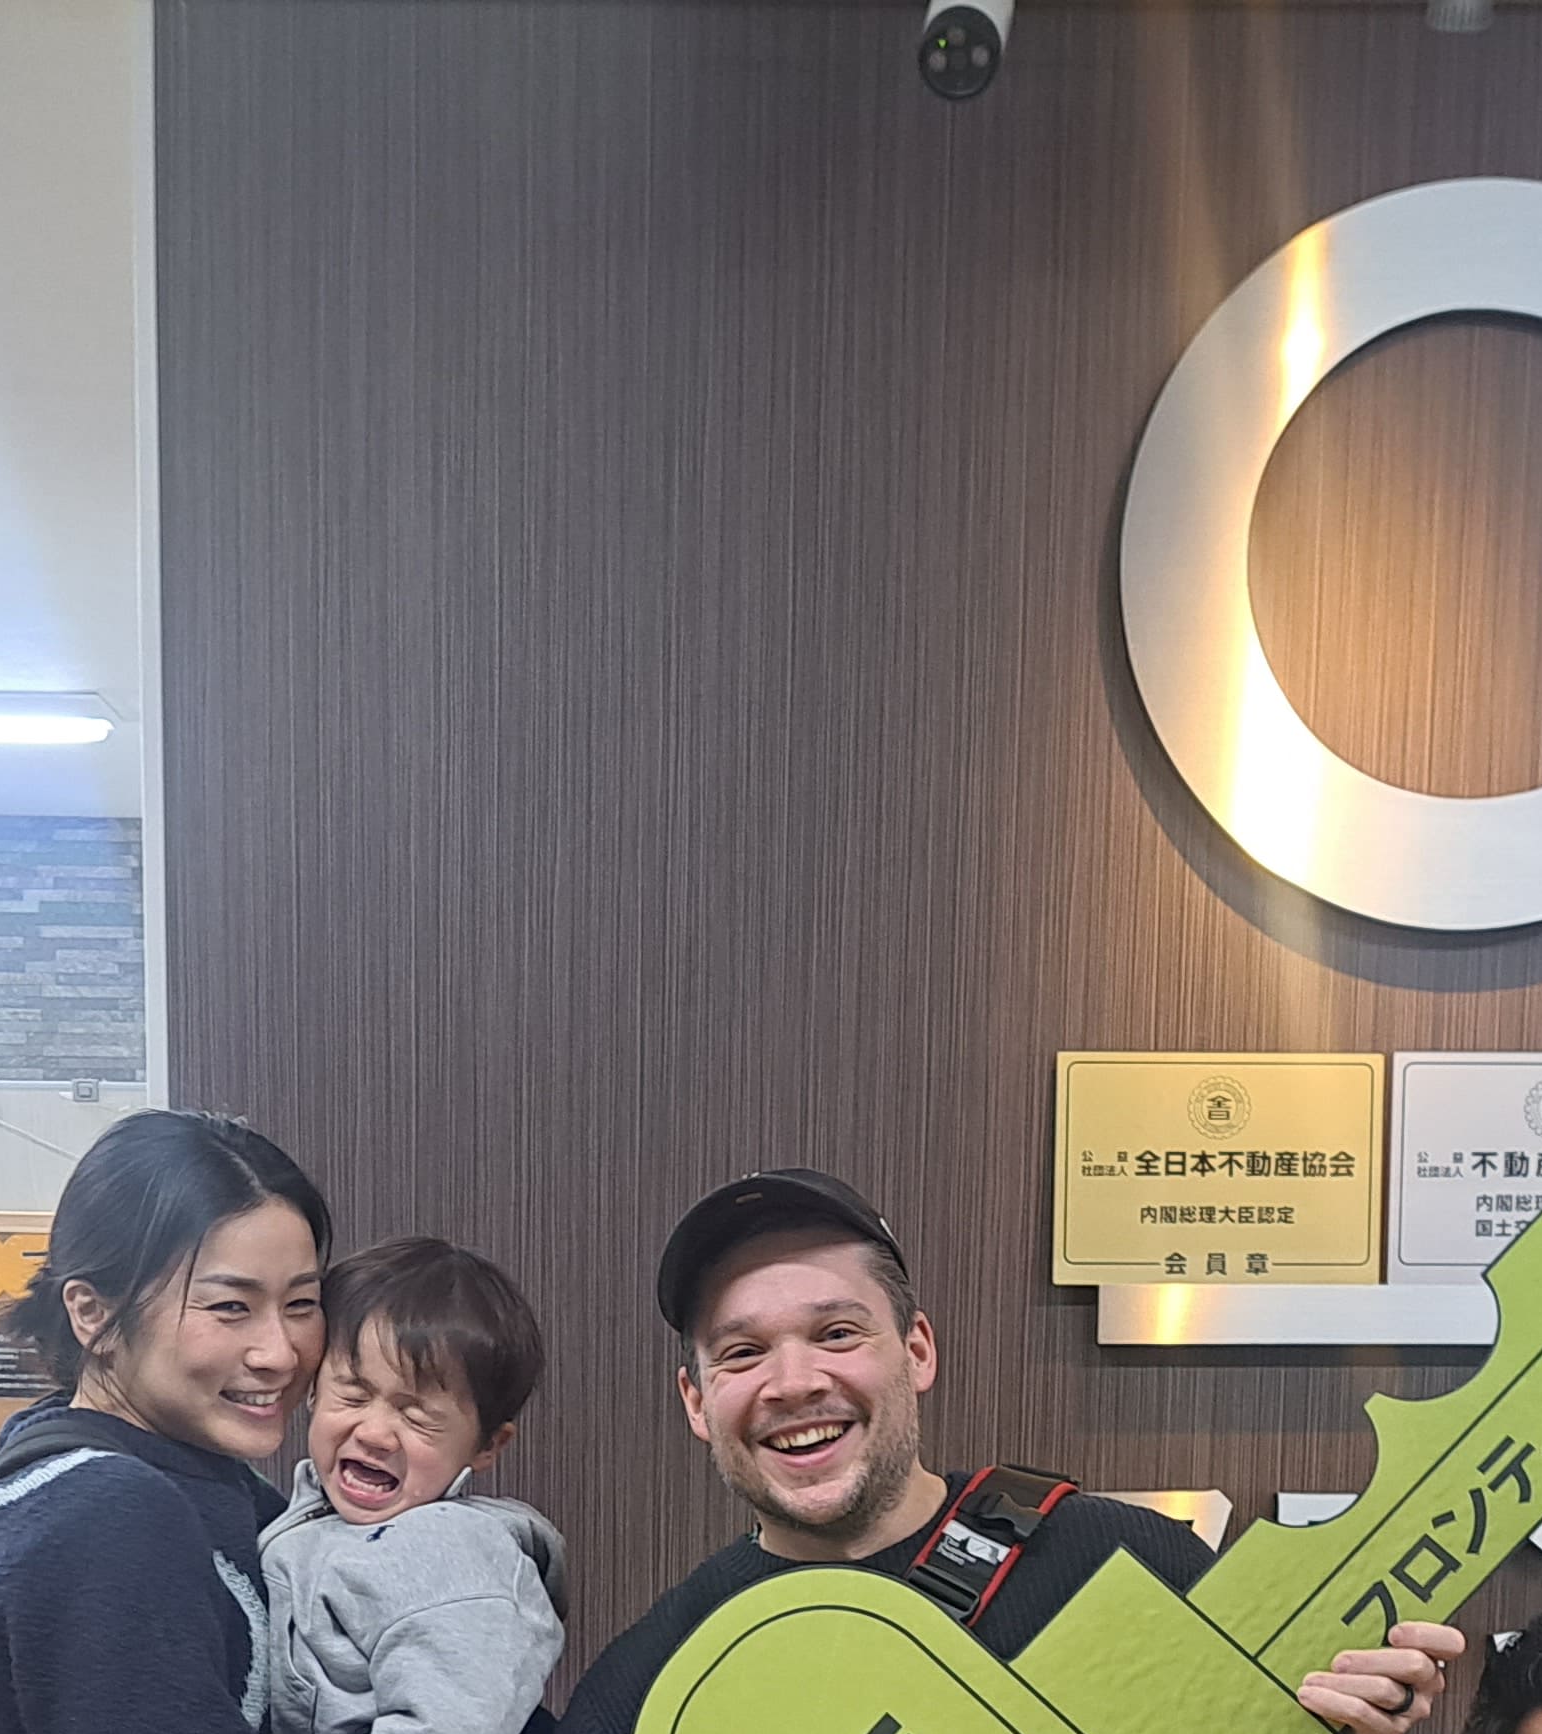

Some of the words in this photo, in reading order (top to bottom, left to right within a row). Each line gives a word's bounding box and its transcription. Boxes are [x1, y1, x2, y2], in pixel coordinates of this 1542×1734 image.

[1081, 1164, 1129, 1177] 社団法人
[1134, 1150, 1356, 1178] 全日本不動産協会
[1417, 1166, 1464, 1178] 社団法人
[1139, 1205, 1296, 1226] 内閣総理大臣認定
[1475, 1219, 1530, 1238] 国土交
[1164, 1252, 1271, 1277] 会員章
